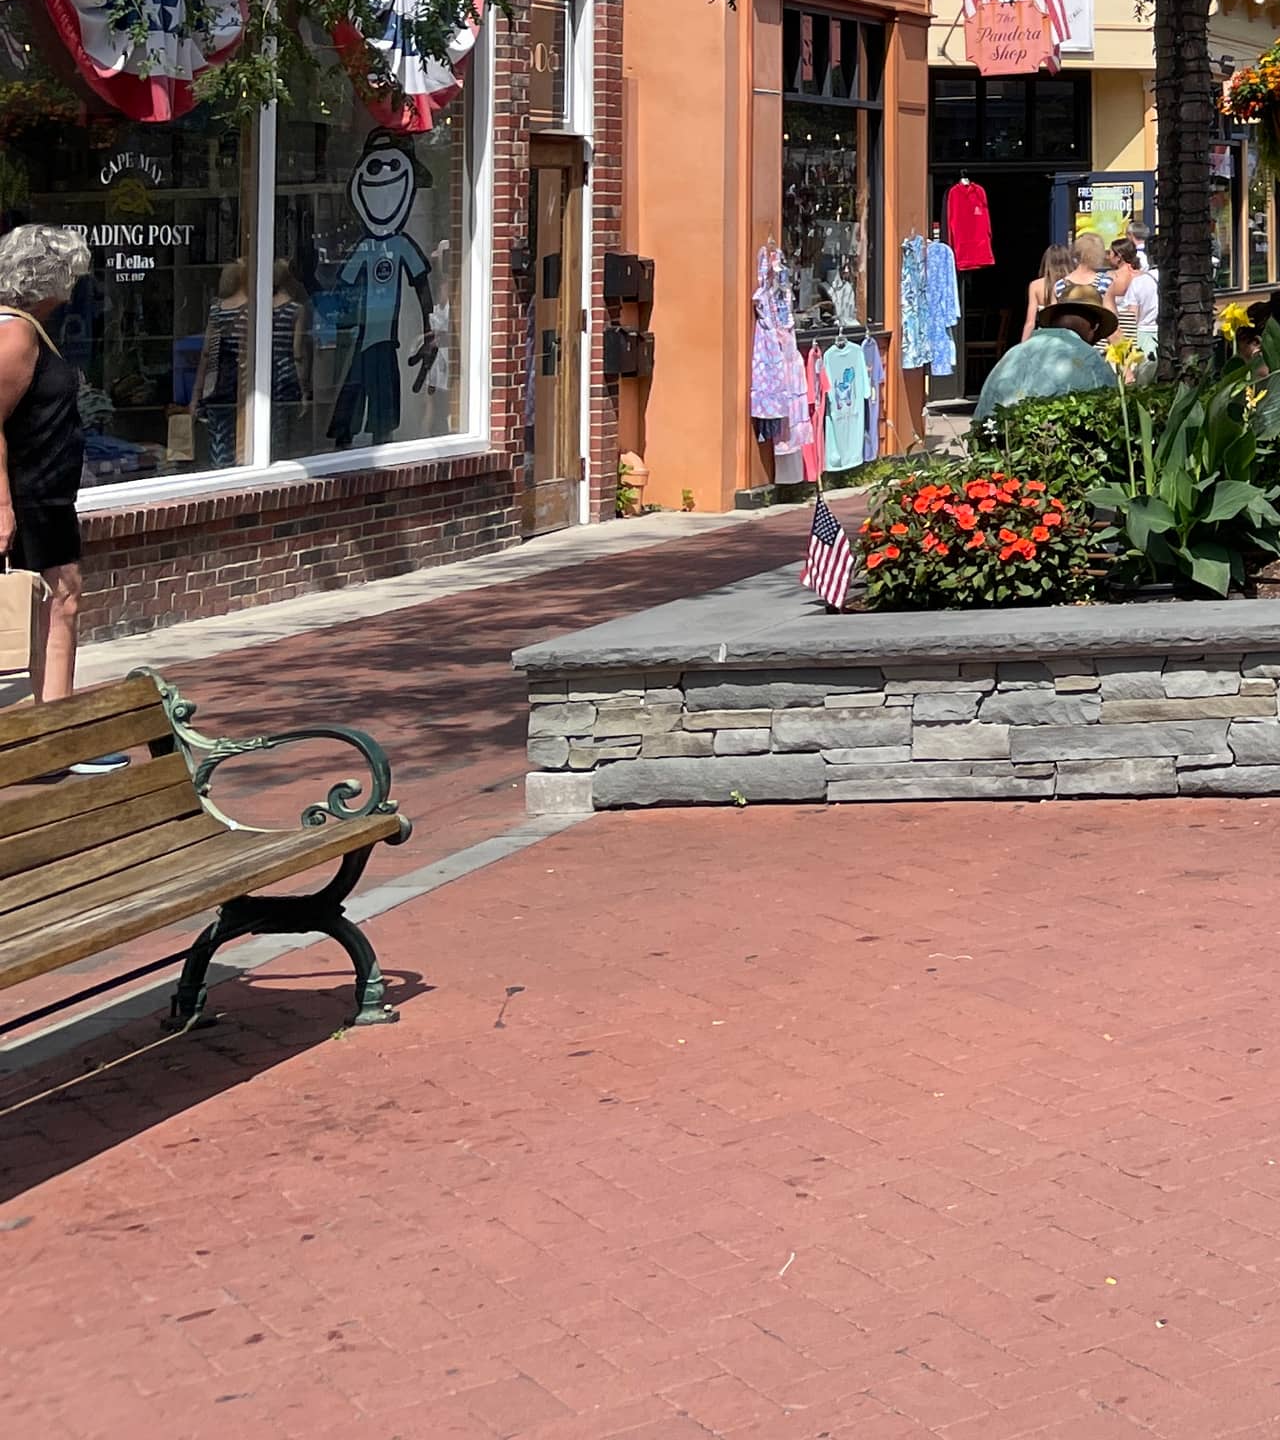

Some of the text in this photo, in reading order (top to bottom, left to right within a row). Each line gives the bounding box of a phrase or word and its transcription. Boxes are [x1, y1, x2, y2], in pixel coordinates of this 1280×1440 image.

[997, 12, 1015, 24] The
[976, 27, 1042, 42] Pandora
[992, 45, 1028, 65] Shop
[100, 151, 163, 185] CAPE MAY
[148, 224, 195, 246] POST
